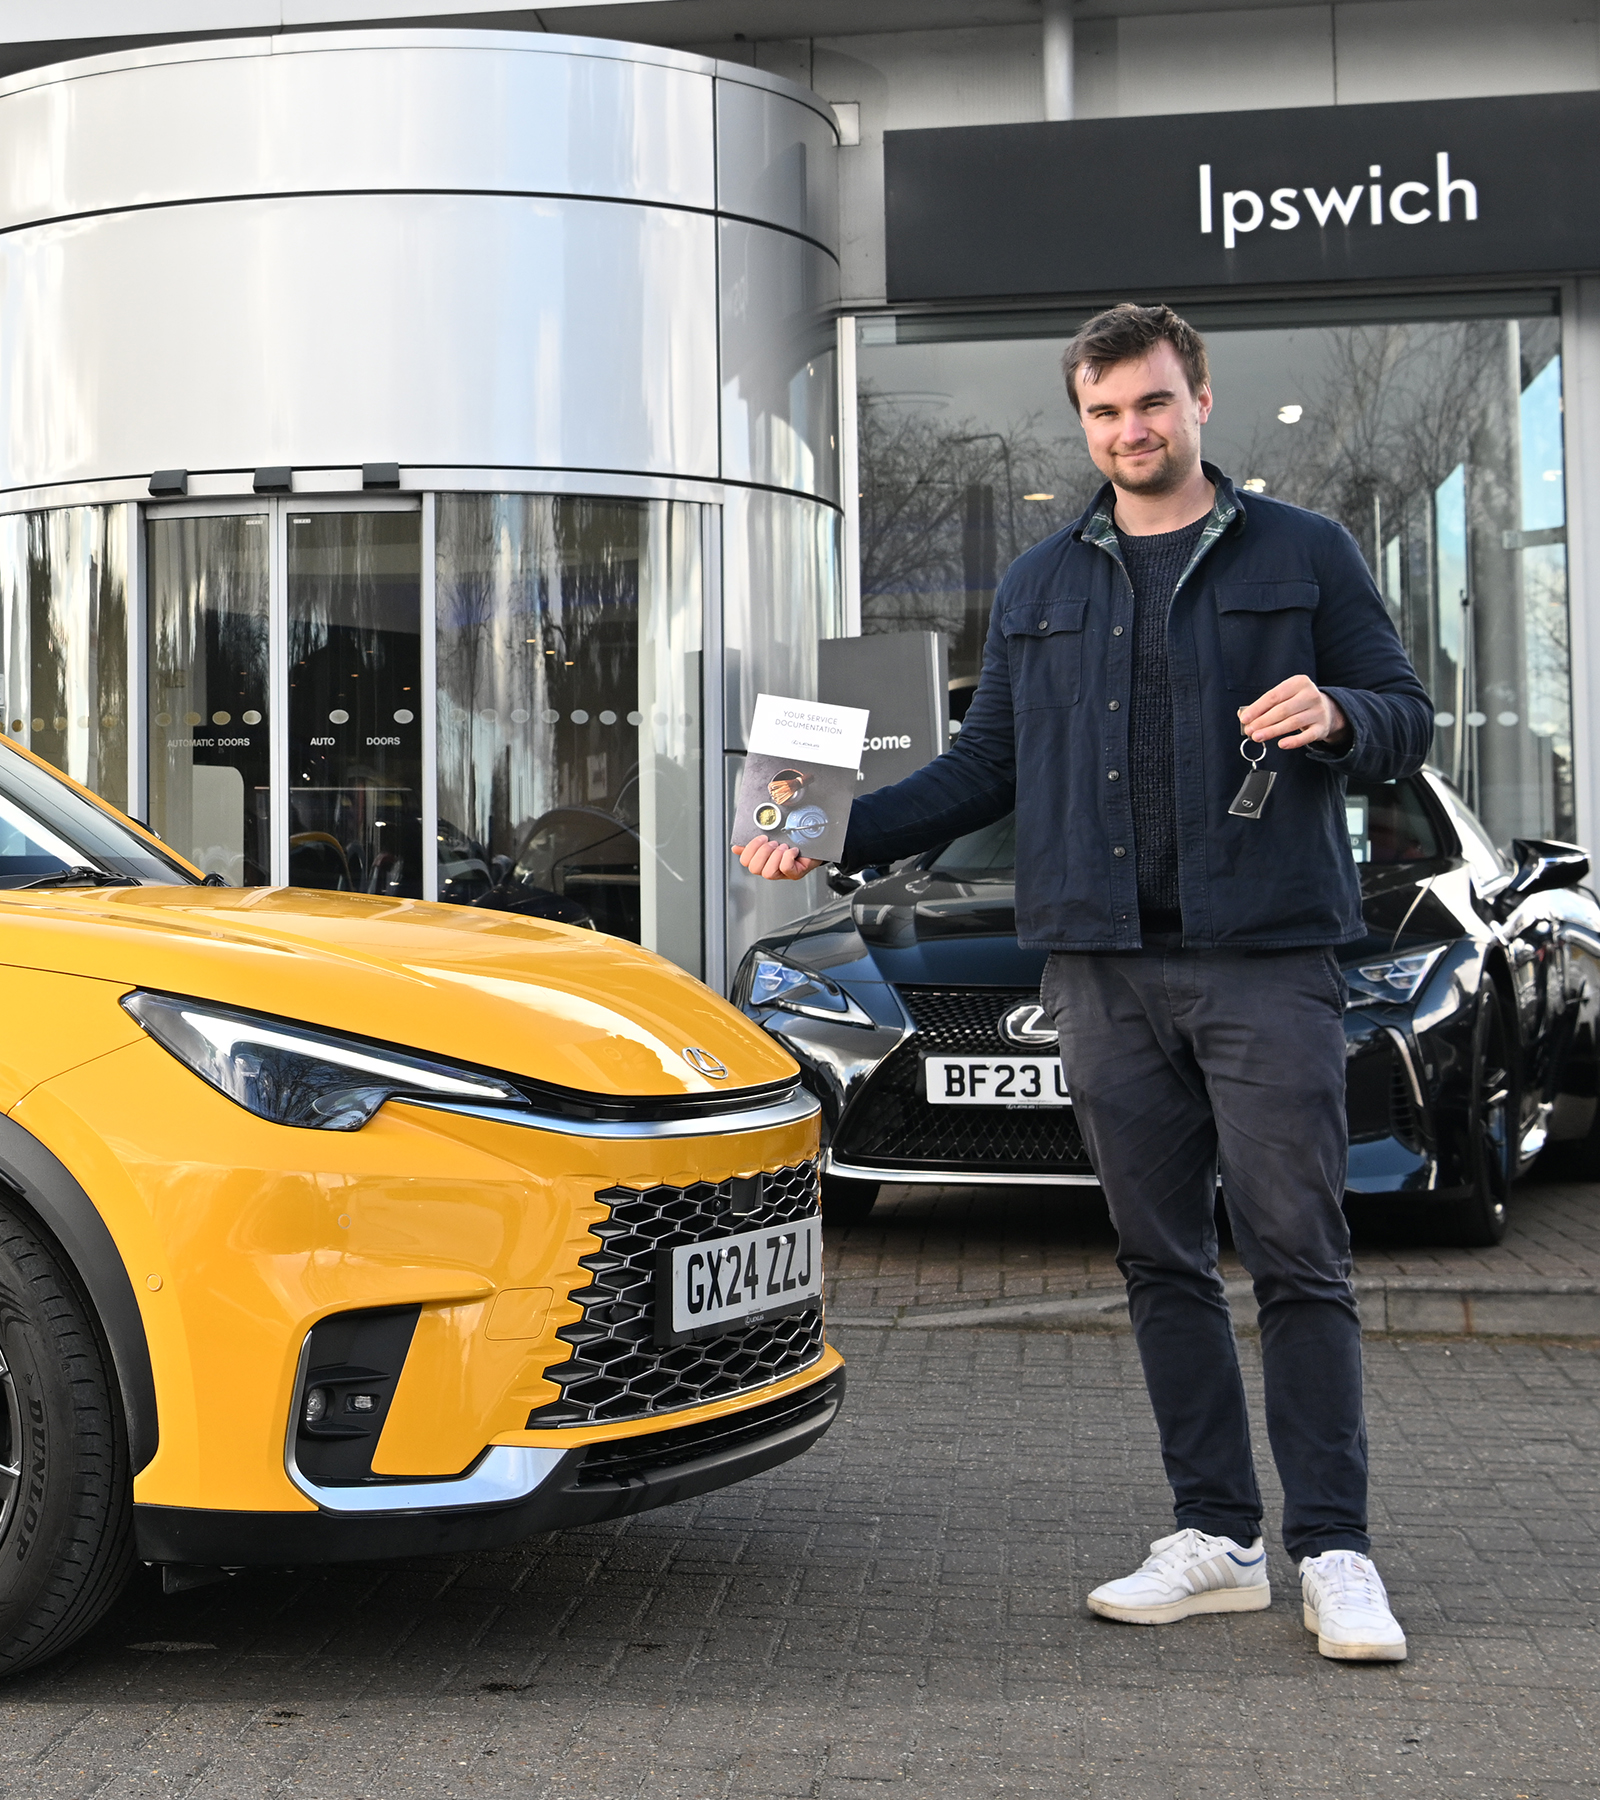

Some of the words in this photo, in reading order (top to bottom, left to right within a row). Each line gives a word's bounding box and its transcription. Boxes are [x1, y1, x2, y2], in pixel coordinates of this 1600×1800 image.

[1199, 151, 1478, 249] Ipswich
[774, 718, 843, 735] DOCUMENTATION
[783, 710, 805, 720] YOUR
[807, 714, 838, 726] SERVICE
[167, 738, 215, 748] AUTOMATIC
[217, 737, 250, 747] DOORS
[310, 737, 335, 746] AUTO
[366, 737, 400, 746] DOORS
[862, 735, 911, 751] come
[943, 1064, 1041, 1098] BF23
[687, 1242, 758, 1315] GX24
[767, 1228, 811, 1296] ZZJ
[17, 1395, 45, 1562] DUNLOP
